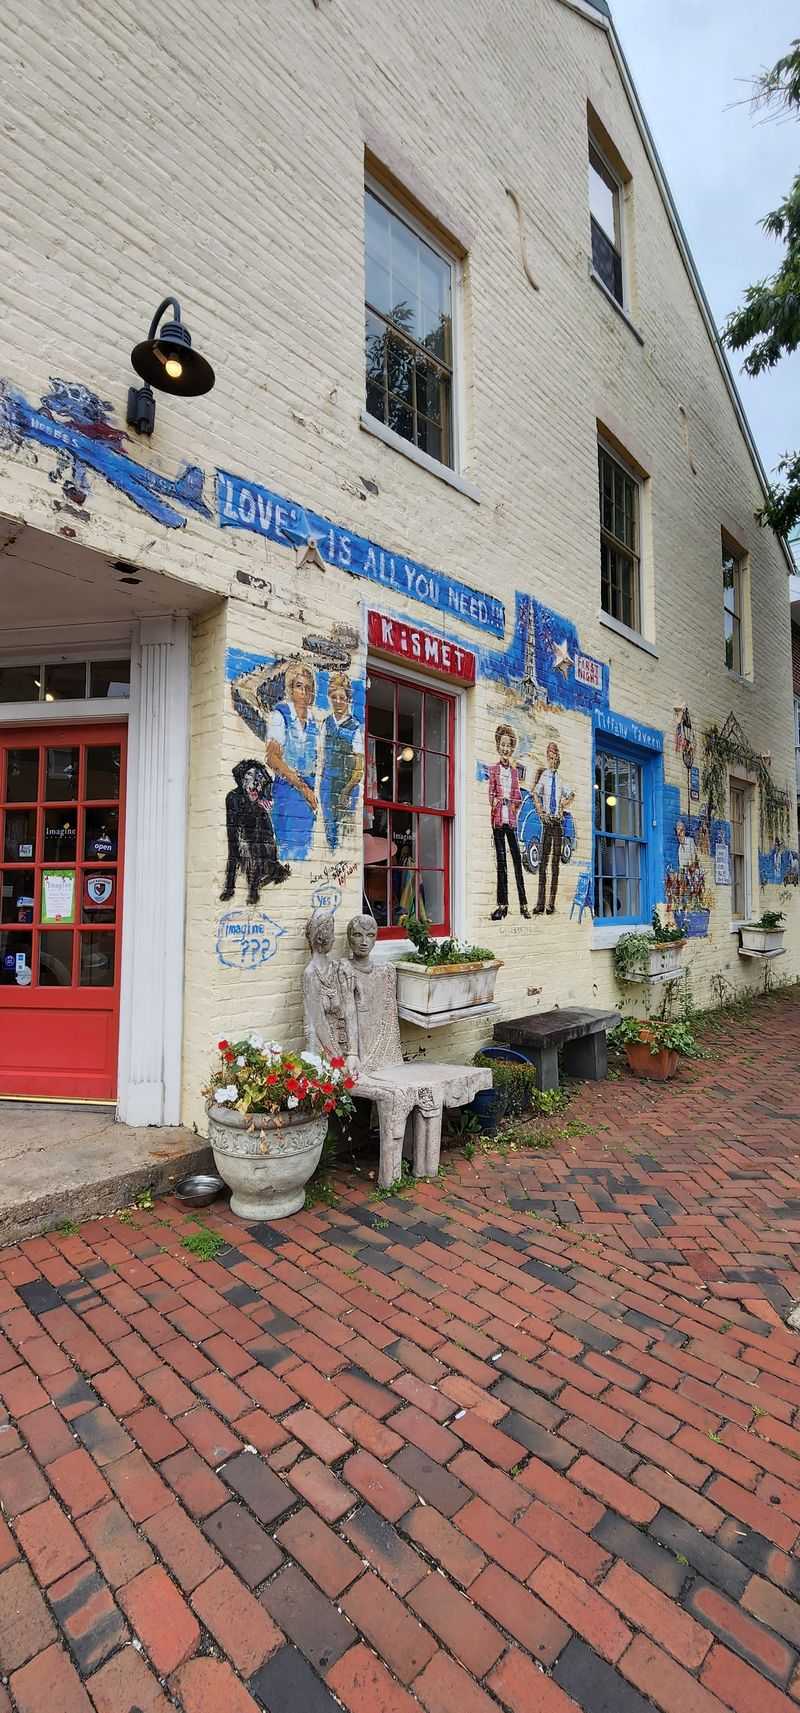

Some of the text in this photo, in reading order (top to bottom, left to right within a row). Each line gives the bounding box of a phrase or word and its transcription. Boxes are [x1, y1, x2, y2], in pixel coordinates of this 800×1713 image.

[328, 529, 352, 565] IS
[364, 547, 400, 586] ALL
[404, 564, 439, 603] YOU
[46, 826, 76, 837] Imagine
[94, 843, 112, 852] open
[240, 940, 271, 962] ???
